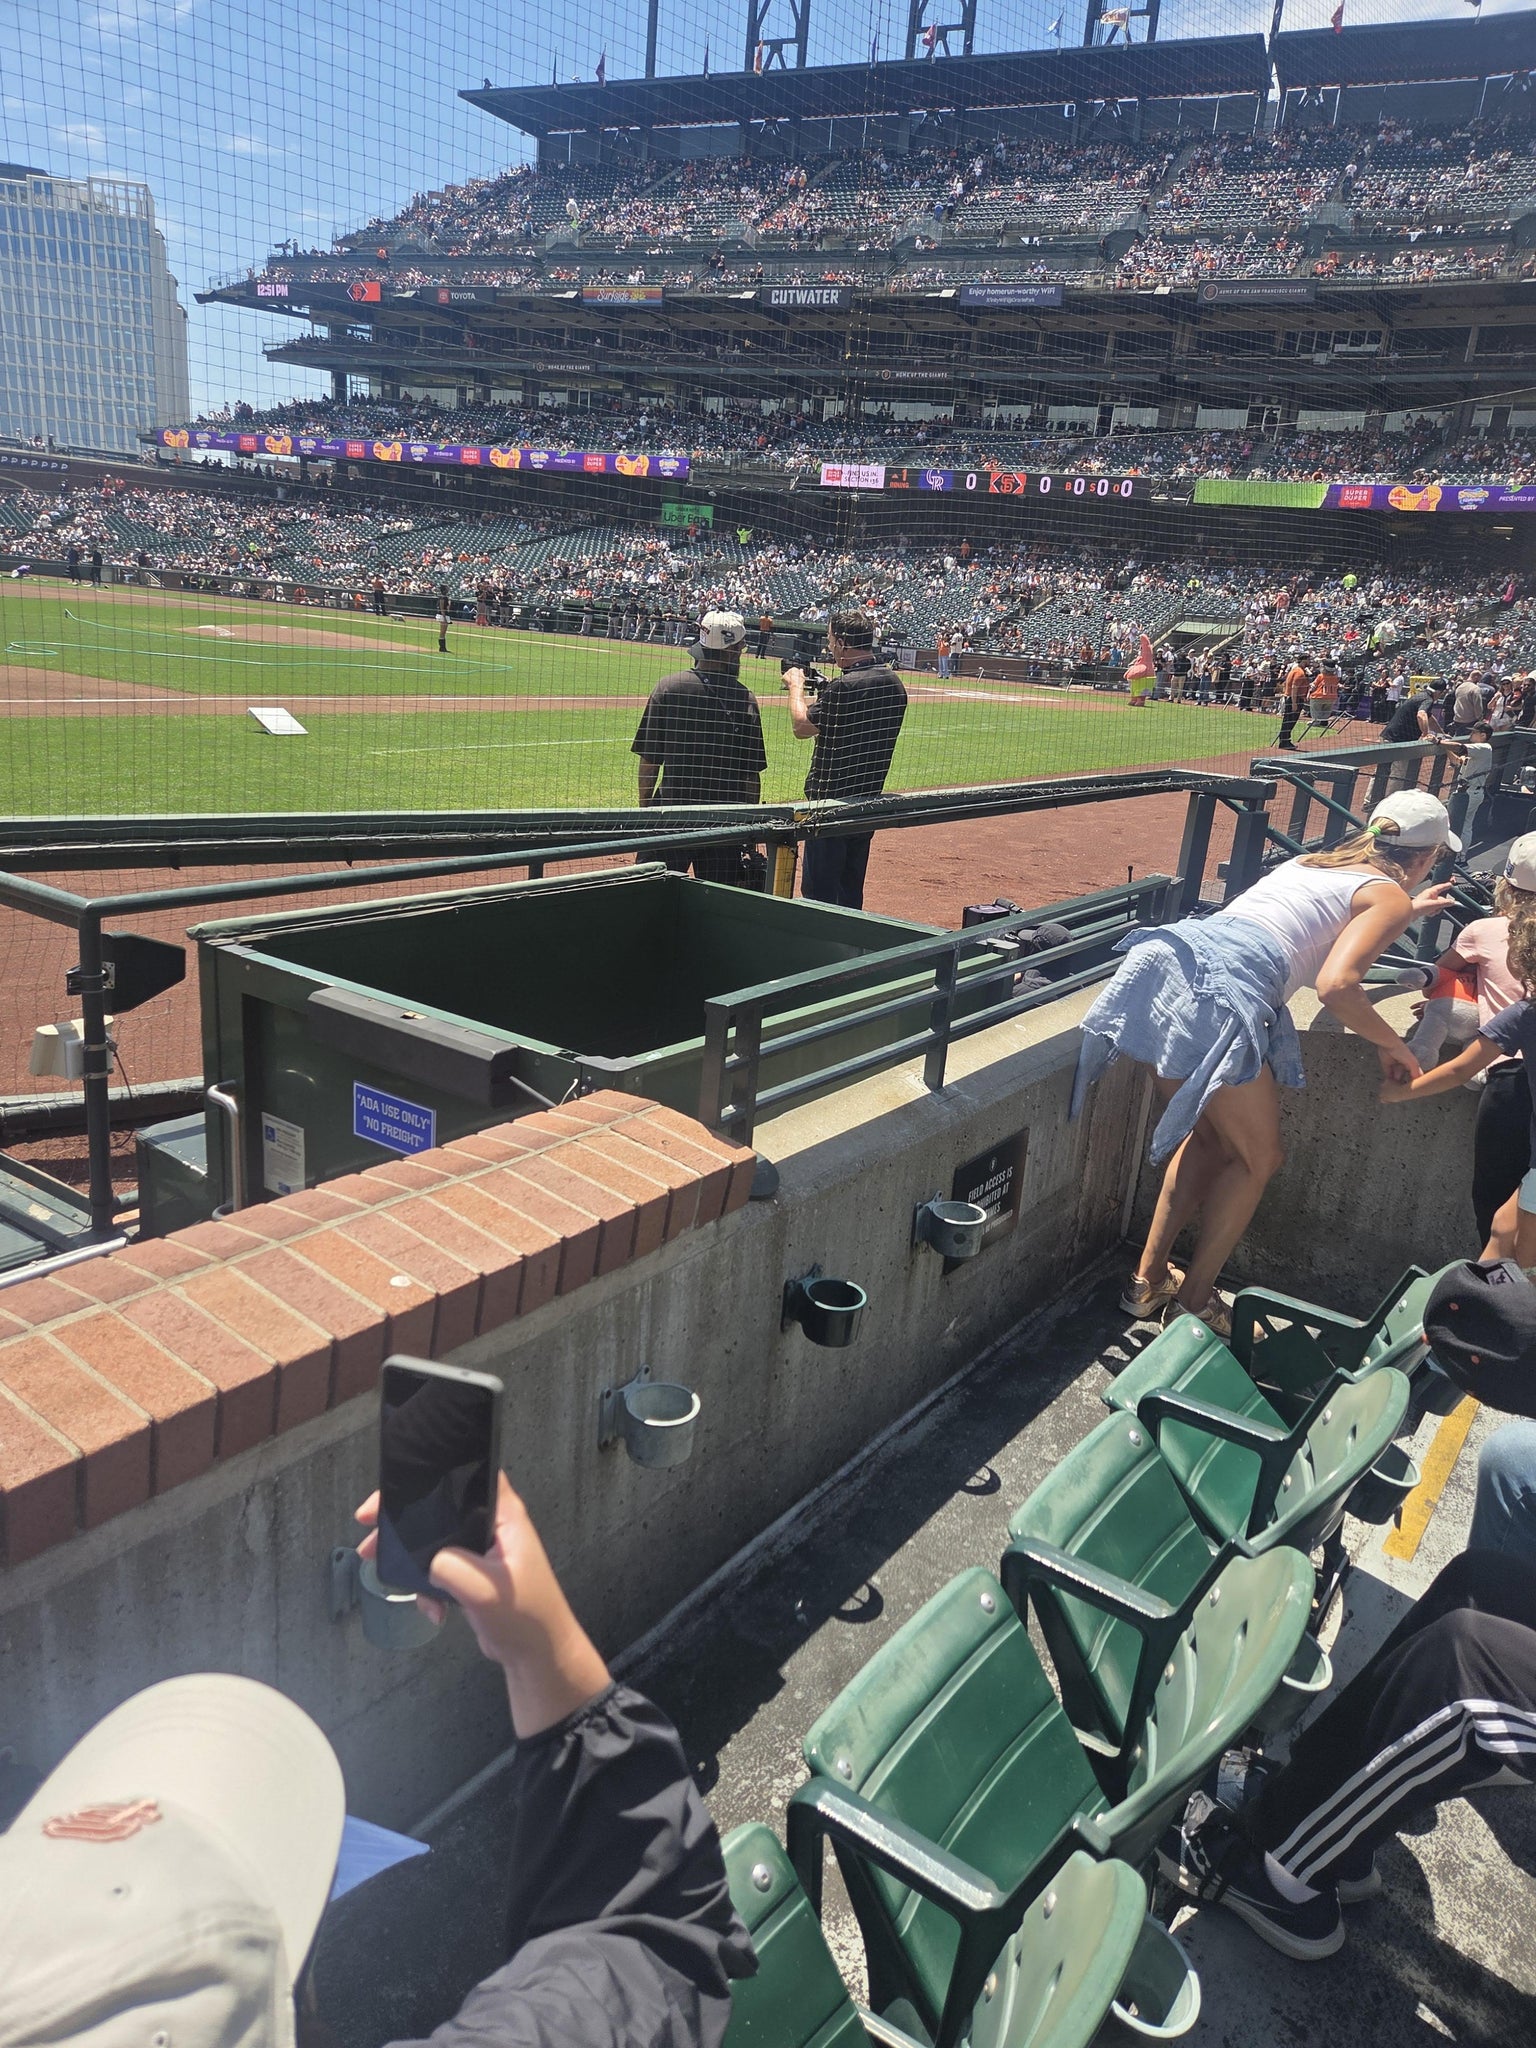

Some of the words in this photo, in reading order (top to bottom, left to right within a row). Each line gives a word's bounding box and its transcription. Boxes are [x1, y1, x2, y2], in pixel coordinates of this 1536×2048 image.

[257, 284, 275, 296] 12:51
[276, 284, 288, 296] PM
[451, 292, 476, 300] TOYOTA
[597, 288, 630, 302] Surfside
[771, 289, 839, 304] CUTWATER
[969, 287, 987, 296] Enjoy
[902, 469, 908, 481] 1
[965, 473, 977, 490] 0
[1039, 476, 1052, 493] 0
[1064, 481, 1072, 491] B
[1073, 477, 1086, 495] 0
[1089, 483, 1096, 492] S
[1097, 479, 1109, 496] 0
[1120, 479, 1133, 497] 0
[664, 512, 687, 524] Uber
[381, 1103, 400, 1120] USE
[968, 1184, 984, 1203] FIELD
[984, 1170, 1006, 1193] ACCESS
[1006, 1166, 1013, 1179] IS
[1002, 1182, 1010, 1196] AT
